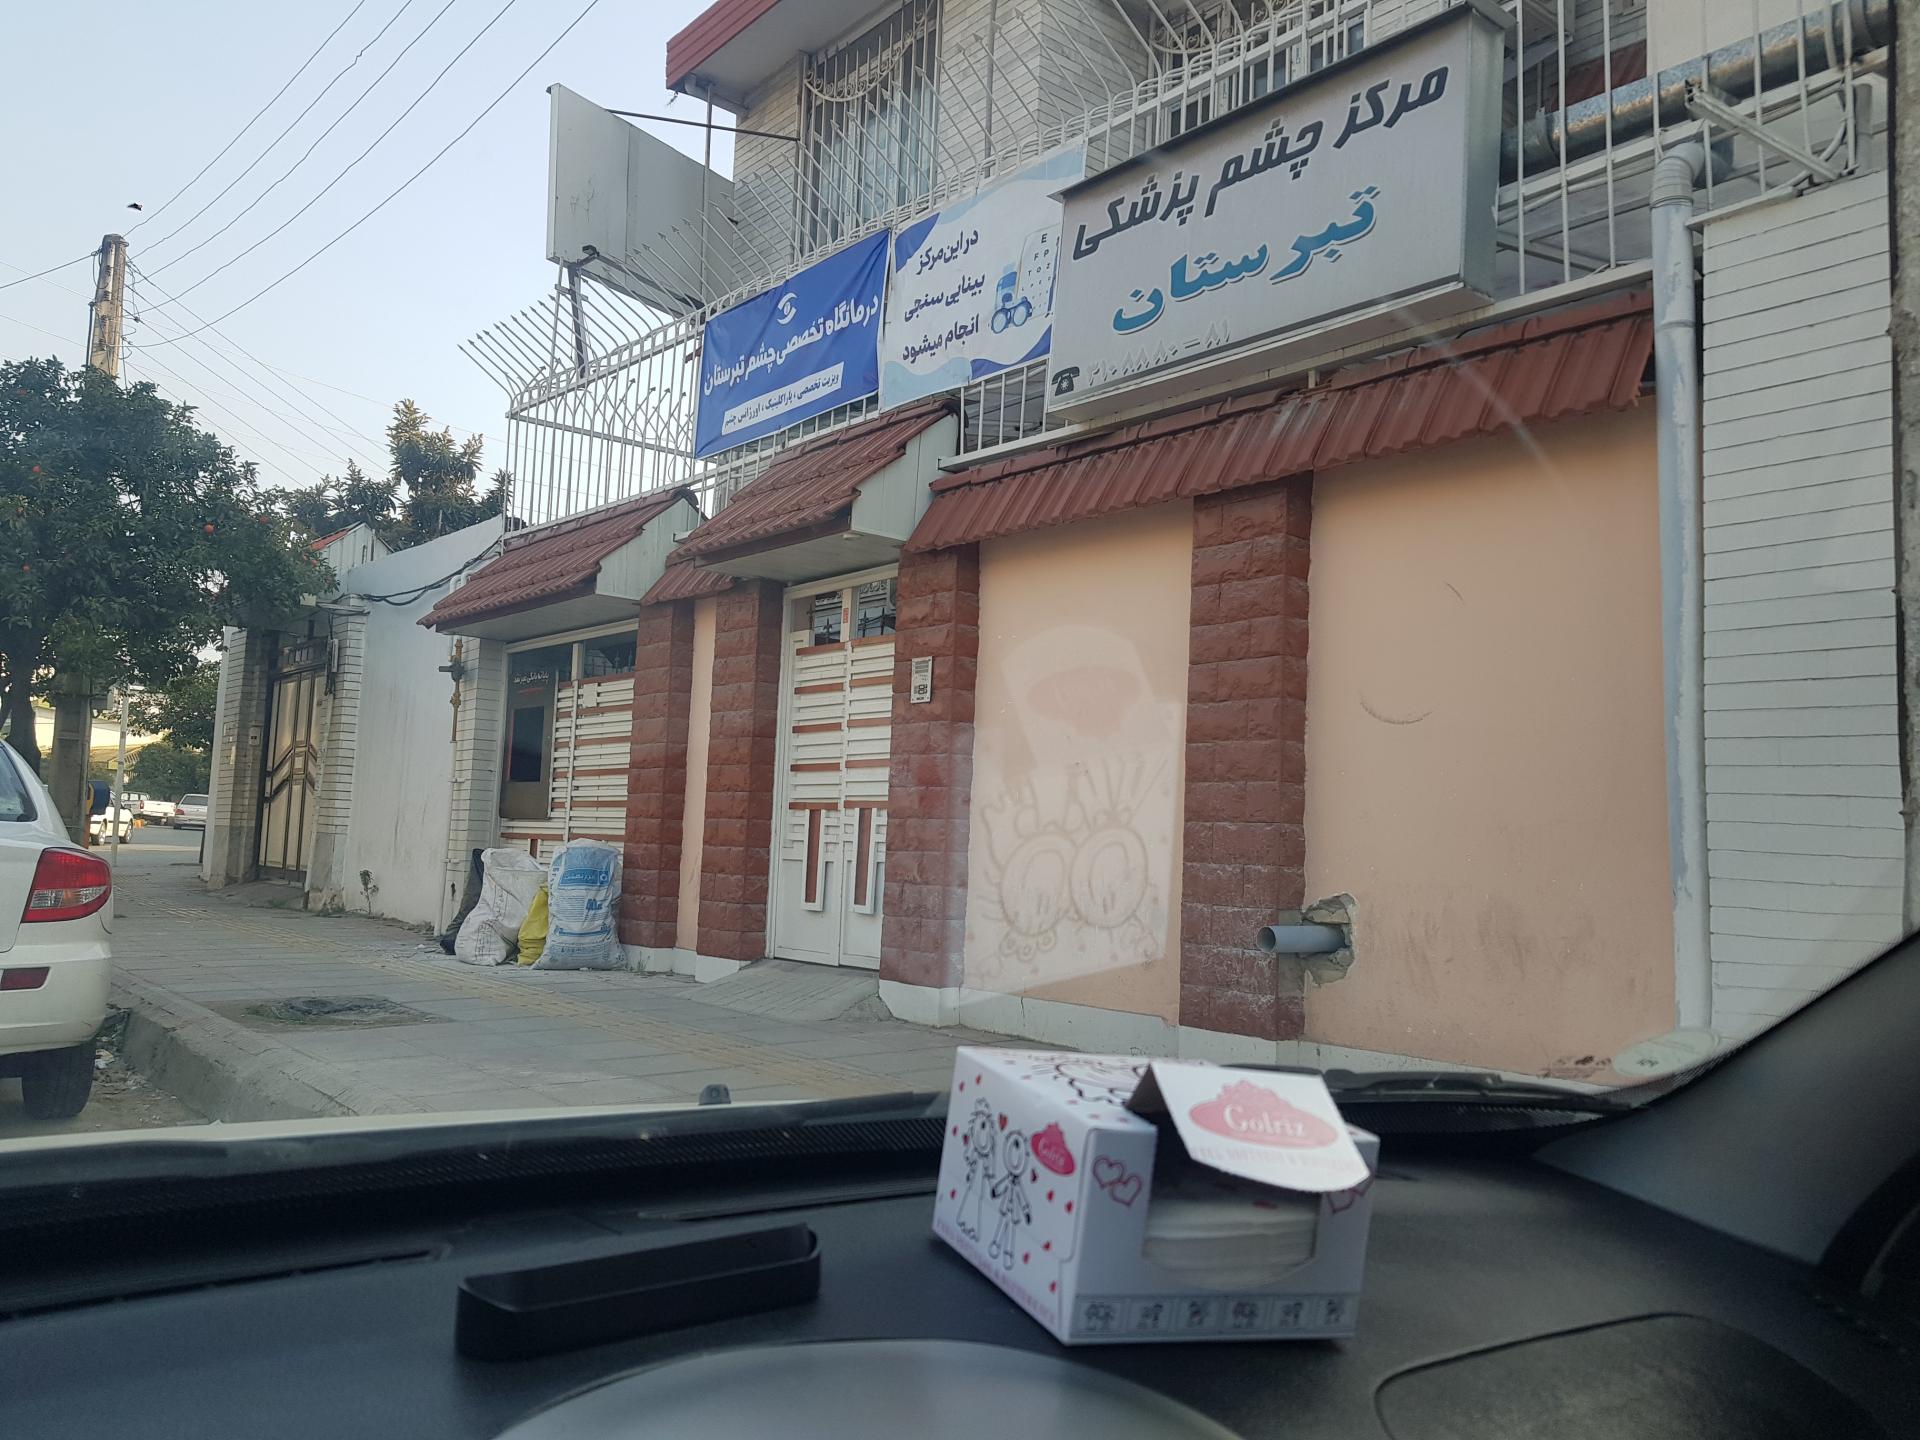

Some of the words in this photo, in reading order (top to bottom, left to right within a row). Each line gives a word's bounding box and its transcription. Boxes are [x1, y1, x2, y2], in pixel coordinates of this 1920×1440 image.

[1333, 65, 1450, 150] مرکز
[1204, 116, 1324, 217] چشم
[1072, 170, 1201, 262] پزشکی
[944, 230, 963, 263] این
[962, 230, 979, 255] در
[1041, 233, 1048, 244] E
[916, 246, 944, 275] مرکز
[1111, 185, 1383, 335] تبرستان
[904, 291, 944, 322] سنجی
[945, 274, 985, 307] بینایی
[825, 294, 879, 336] درمانگاه
[945, 313, 979, 350] انجام
[744, 340, 777, 381] چشم
[776, 317, 825, 366] تخصصی
[903, 334, 943, 364] میشود
[703, 353, 746, 396] تبرستان
